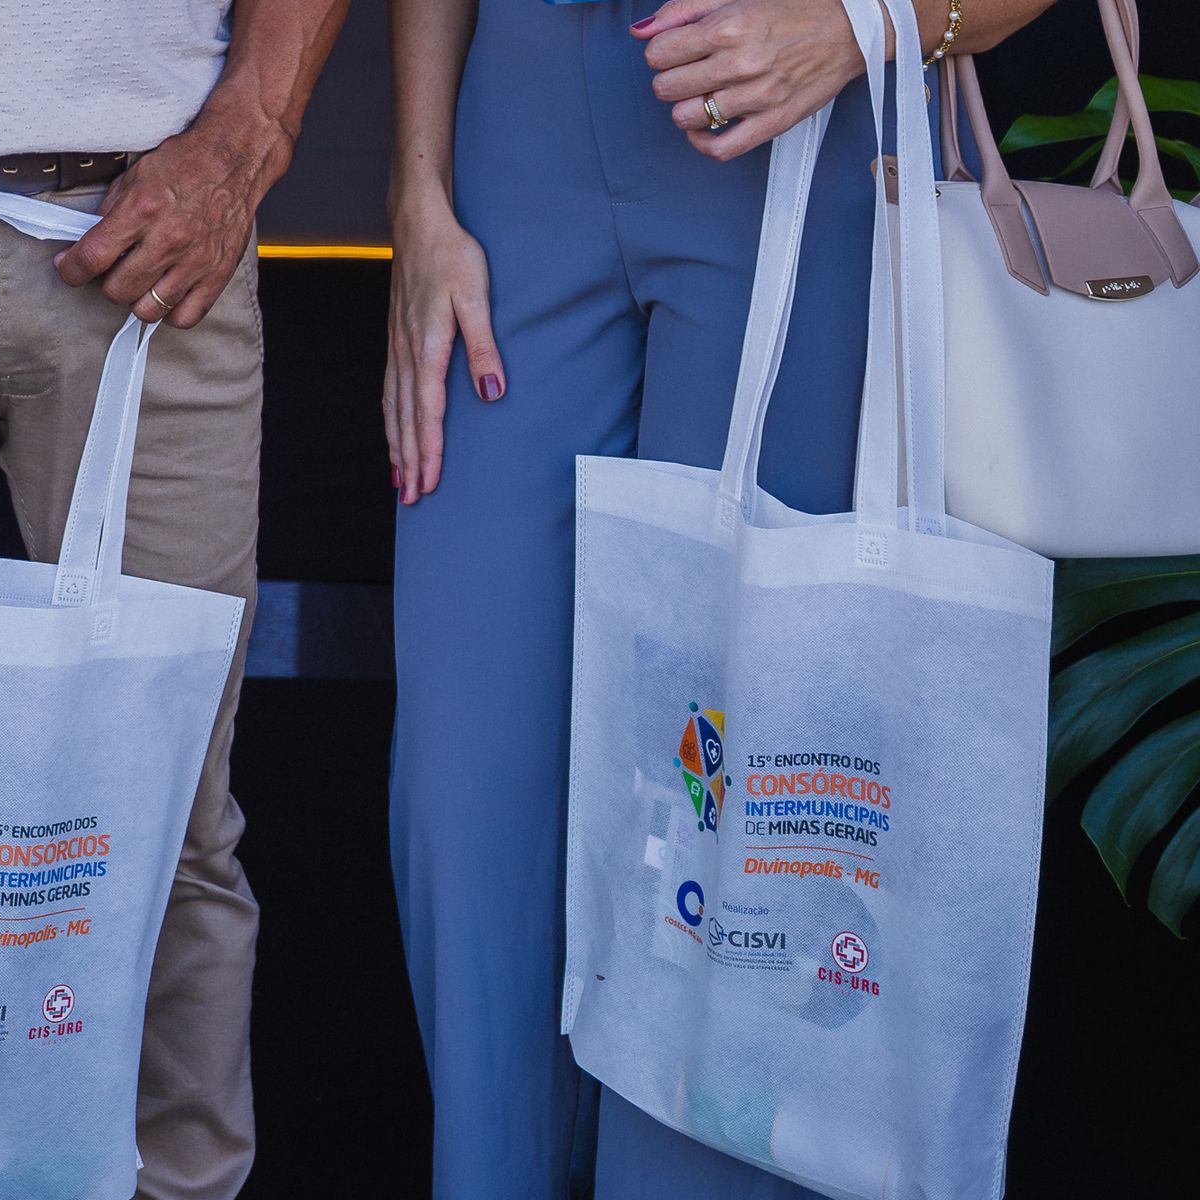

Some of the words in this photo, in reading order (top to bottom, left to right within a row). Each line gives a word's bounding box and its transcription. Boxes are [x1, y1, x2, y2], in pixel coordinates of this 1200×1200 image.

[774, 752, 850, 768] ENCONTRO
[854, 757, 881, 775] DOS
[746, 767, 892, 810] CONSÓRCIOS
[11, 820, 73, 838] ENCONTRO
[74, 816, 98, 831] DOS
[745, 800, 890, 832] INTERMUNICIPAIS
[745, 820, 766, 835] DE
[768, 820, 821, 835] MINAS
[824, 821, 878, 847] GERAIS
[744, 857, 843, 879] Divinopolis
[854, 866, 881, 889] MG
[0, 889, 47, 907] MINAS
[47, 882, 91, 902] GERAIS
[722, 901, 769, 915] Realização
[67, 918, 92, 937] MG
[728, 930, 786, 950] CISVI
[817, 966, 880, 996] CIS-URG
[28, 1020, 83, 1040] CIS-URG
